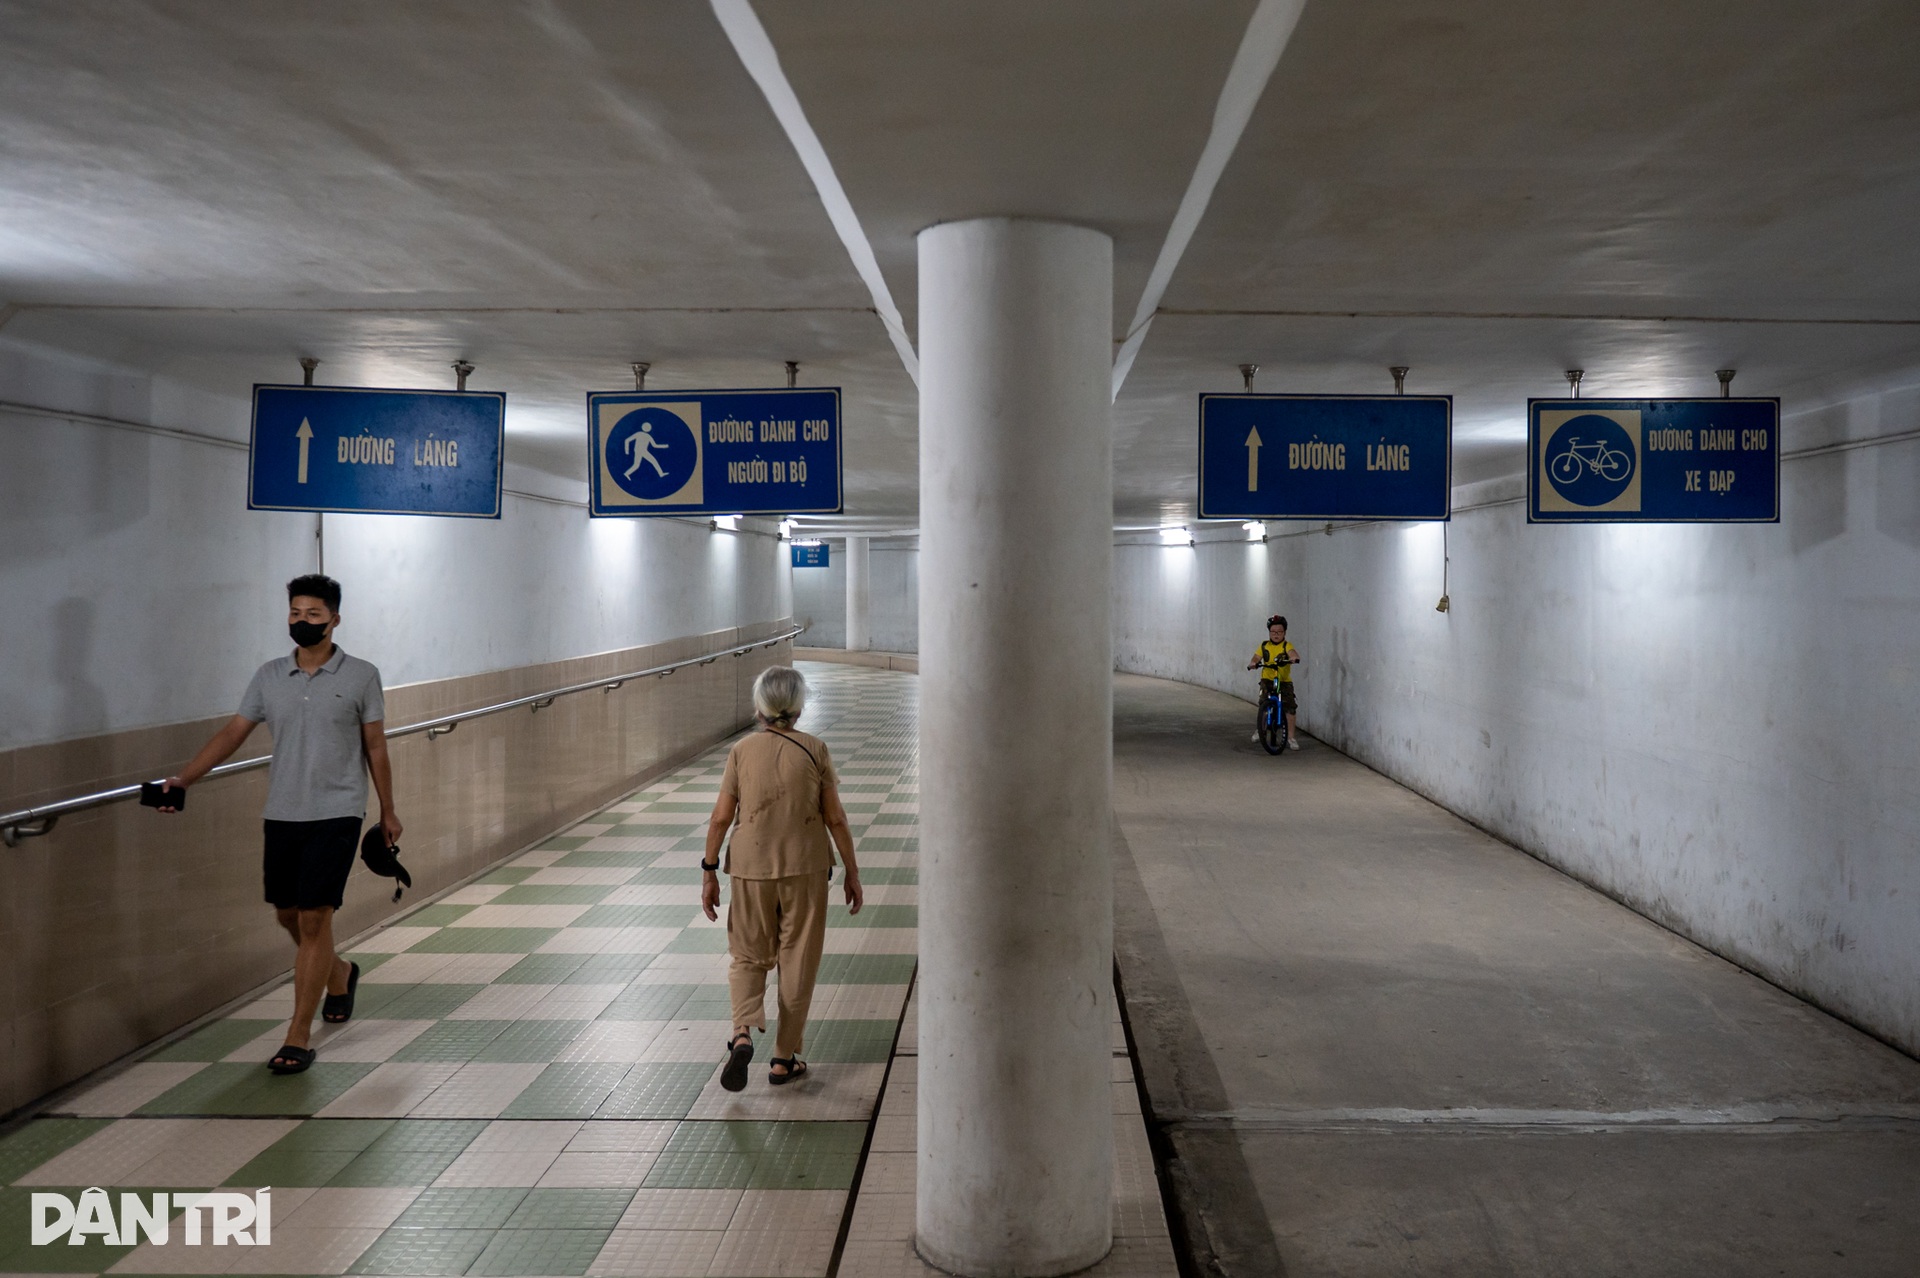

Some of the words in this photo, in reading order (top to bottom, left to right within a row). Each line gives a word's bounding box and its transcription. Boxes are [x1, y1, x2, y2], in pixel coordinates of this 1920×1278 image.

[709, 414, 754, 443] ĐƯỜNG
[760, 415, 797, 442] DÀNH
[803, 419, 830, 442] CHO
[1649, 423, 1693, 451] ĐƯỜNG
[1700, 423, 1736, 451] DÀNH
[1741, 429, 1768, 451] CHO
[337, 427, 395, 465] ĐƯỜNG
[414, 433, 458, 467] LÁNG
[1289, 434, 1346, 470] ĐƯỜNG
[1366, 437, 1410, 471] LÁNG
[728, 454, 769, 484] NGƯỜI
[772, 461, 786, 483] ĐI
[789, 456, 807, 488] BỘ
[1685, 470, 1702, 492] XE
[1709, 470, 1736, 497] ĐẠP
